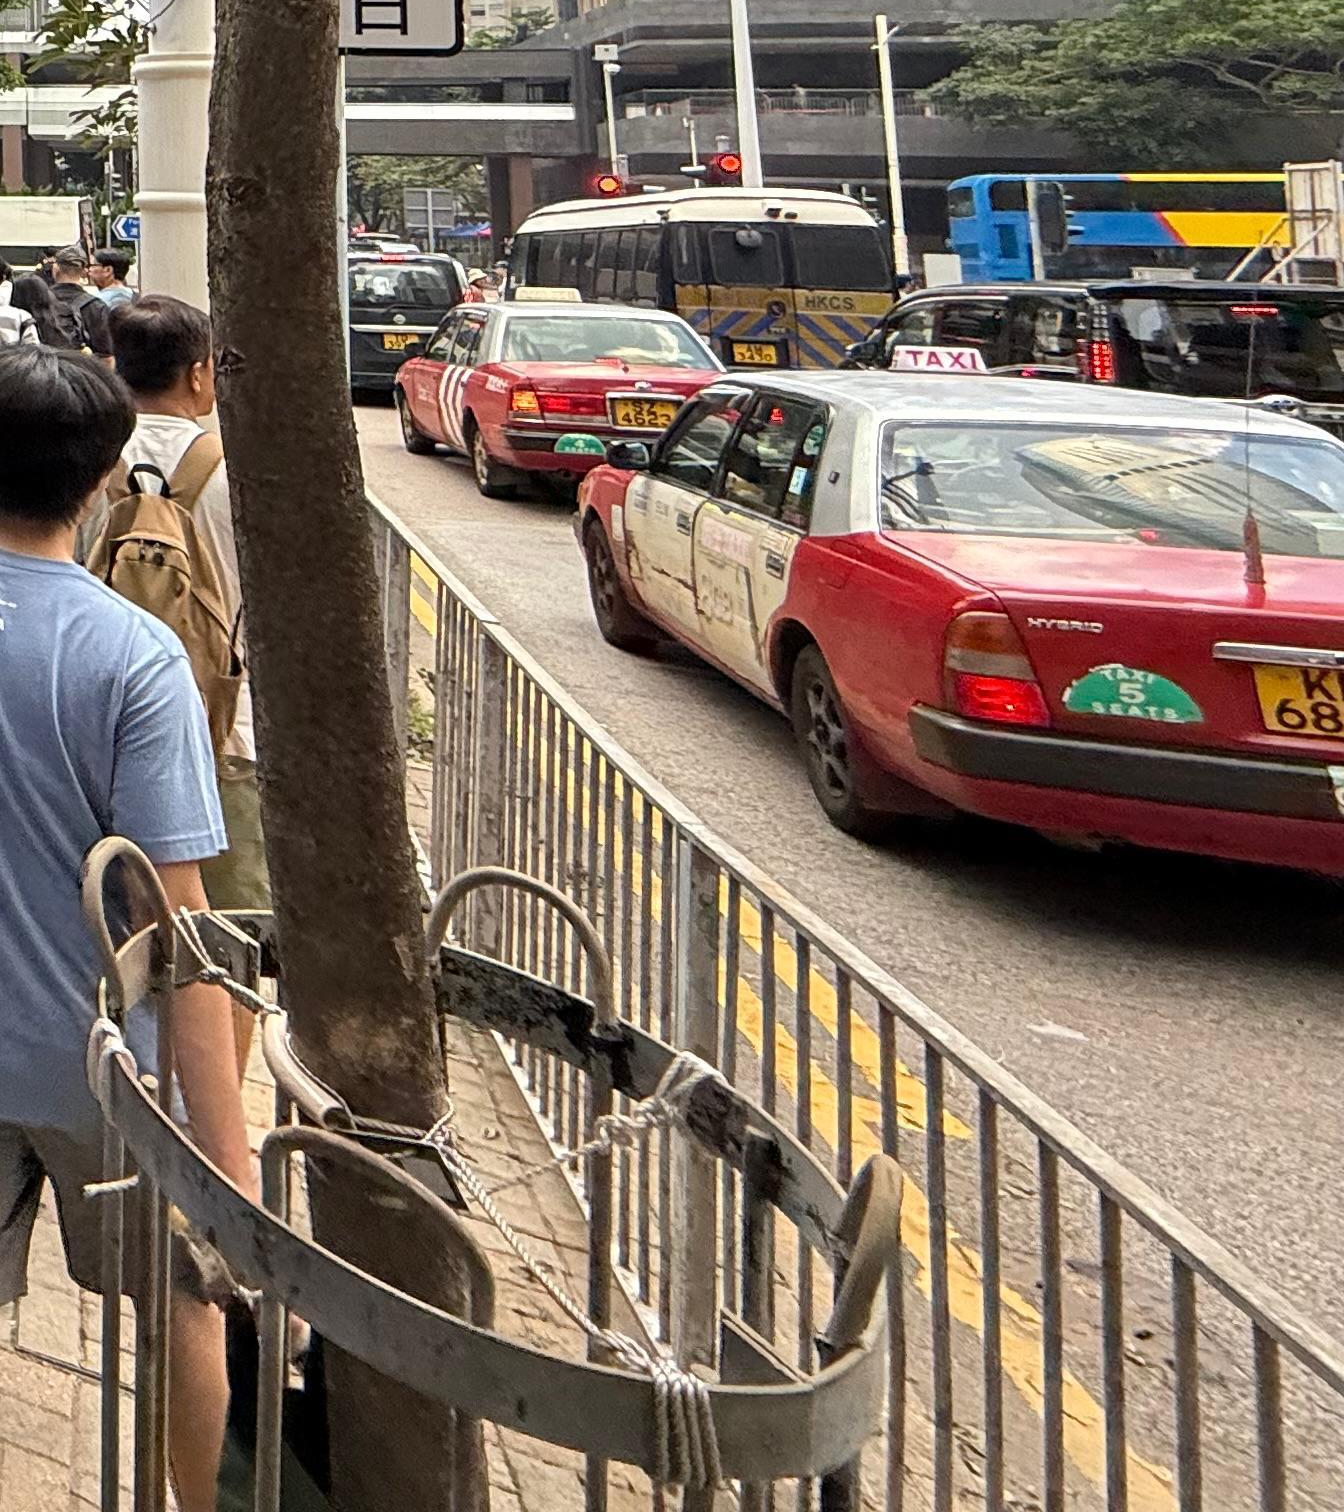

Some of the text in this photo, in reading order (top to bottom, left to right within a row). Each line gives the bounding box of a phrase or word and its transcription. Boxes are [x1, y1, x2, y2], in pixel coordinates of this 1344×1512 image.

[805, 296, 855, 311] HKCS
[905, 350, 978, 369] TAXI
[621, 412, 672, 427] 4623
[1027, 617, 1104, 634] HYBRID
[1099, 668, 1155, 685] TAXI
[1118, 682, 1146, 704] 5
[1091, 700, 1179, 720] SEATS
